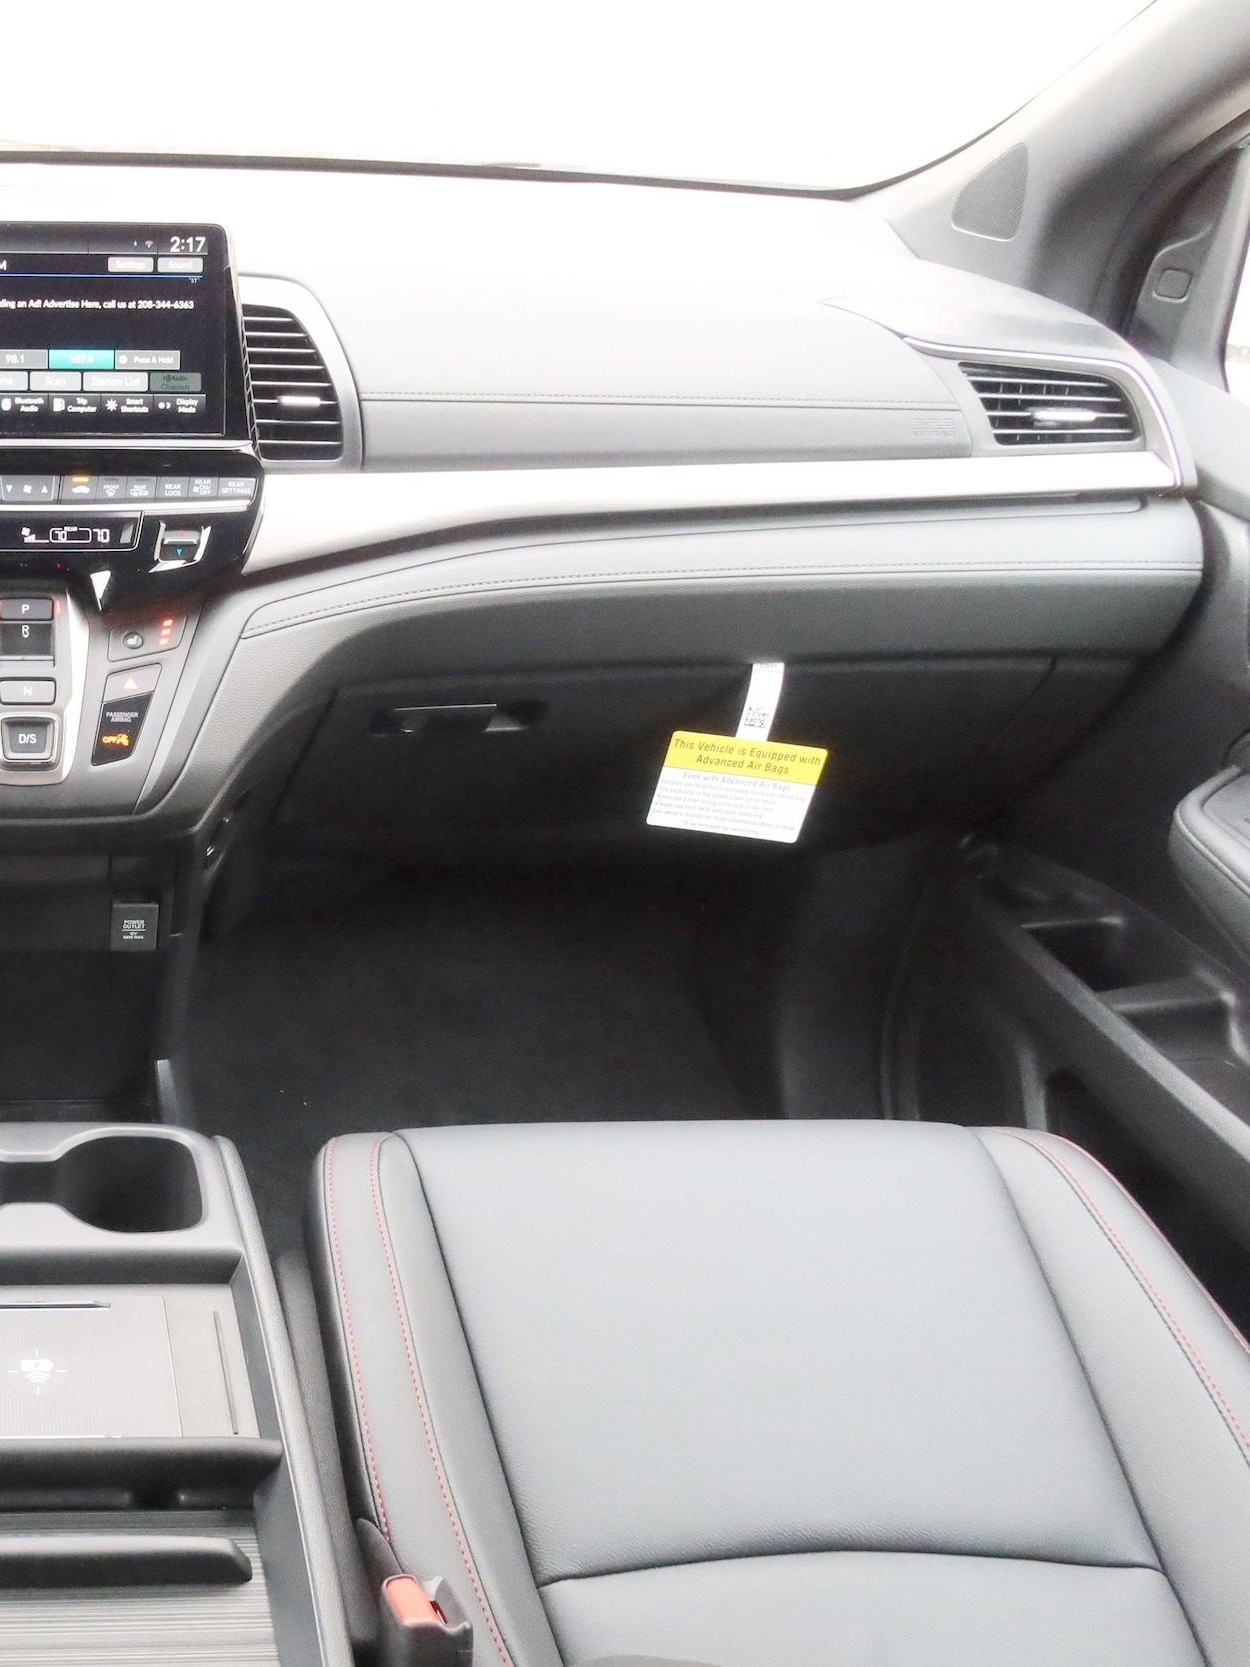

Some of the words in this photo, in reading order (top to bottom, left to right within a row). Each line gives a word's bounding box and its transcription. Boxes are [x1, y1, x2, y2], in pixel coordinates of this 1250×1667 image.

[170, 237, 206, 253] 2:17
[116, 261, 146, 270] Settings
[169, 261, 192, 270] Sound
[43, 299, 80, 309] Advertise
[81, 300, 102, 310] Here,
[103, 300, 116, 309] call
[128, 300, 136, 309] at
[5, 355, 25, 364] 98.1
[69, 355, 95, 364] 107.9
[133, 356, 151, 364] Press
[158, 356, 174, 364] Hold
[45, 377, 67, 386] Scan
[91, 377, 124, 386] Station
[125, 377, 141, 386] List
[76, 398, 88, 406] Trip
[176, 398, 199, 406] Display
[20, 405, 39, 413] Audio
[67, 405, 97, 414] Computer
[178, 405, 197, 414] Mode
[55, 531, 67, 541] 70
[92, 528, 110, 543] 70
[22, 604, 30, 614] P
[22, 625, 30, 635] R
[23, 686, 33, 696] N
[18, 733, 38, 745] D/S
[102, 736, 118, 744] OFF
[674, 738, 695, 751] This
[698, 741, 735, 755] Vehicle
[737, 745, 747, 756] is
[750, 747, 796, 763] Equipped
[799, 753, 822, 766] with
[696, 755, 745, 770] Advanced
[747, 760, 763, 771] Air
[764, 762, 790, 775] Bags
[683, 771, 702, 781] Even
[703, 773, 719, 782] with
[721, 776, 758, 787] Advanced
[759, 781, 771, 789] Air
[772, 782, 791, 792] Bags
